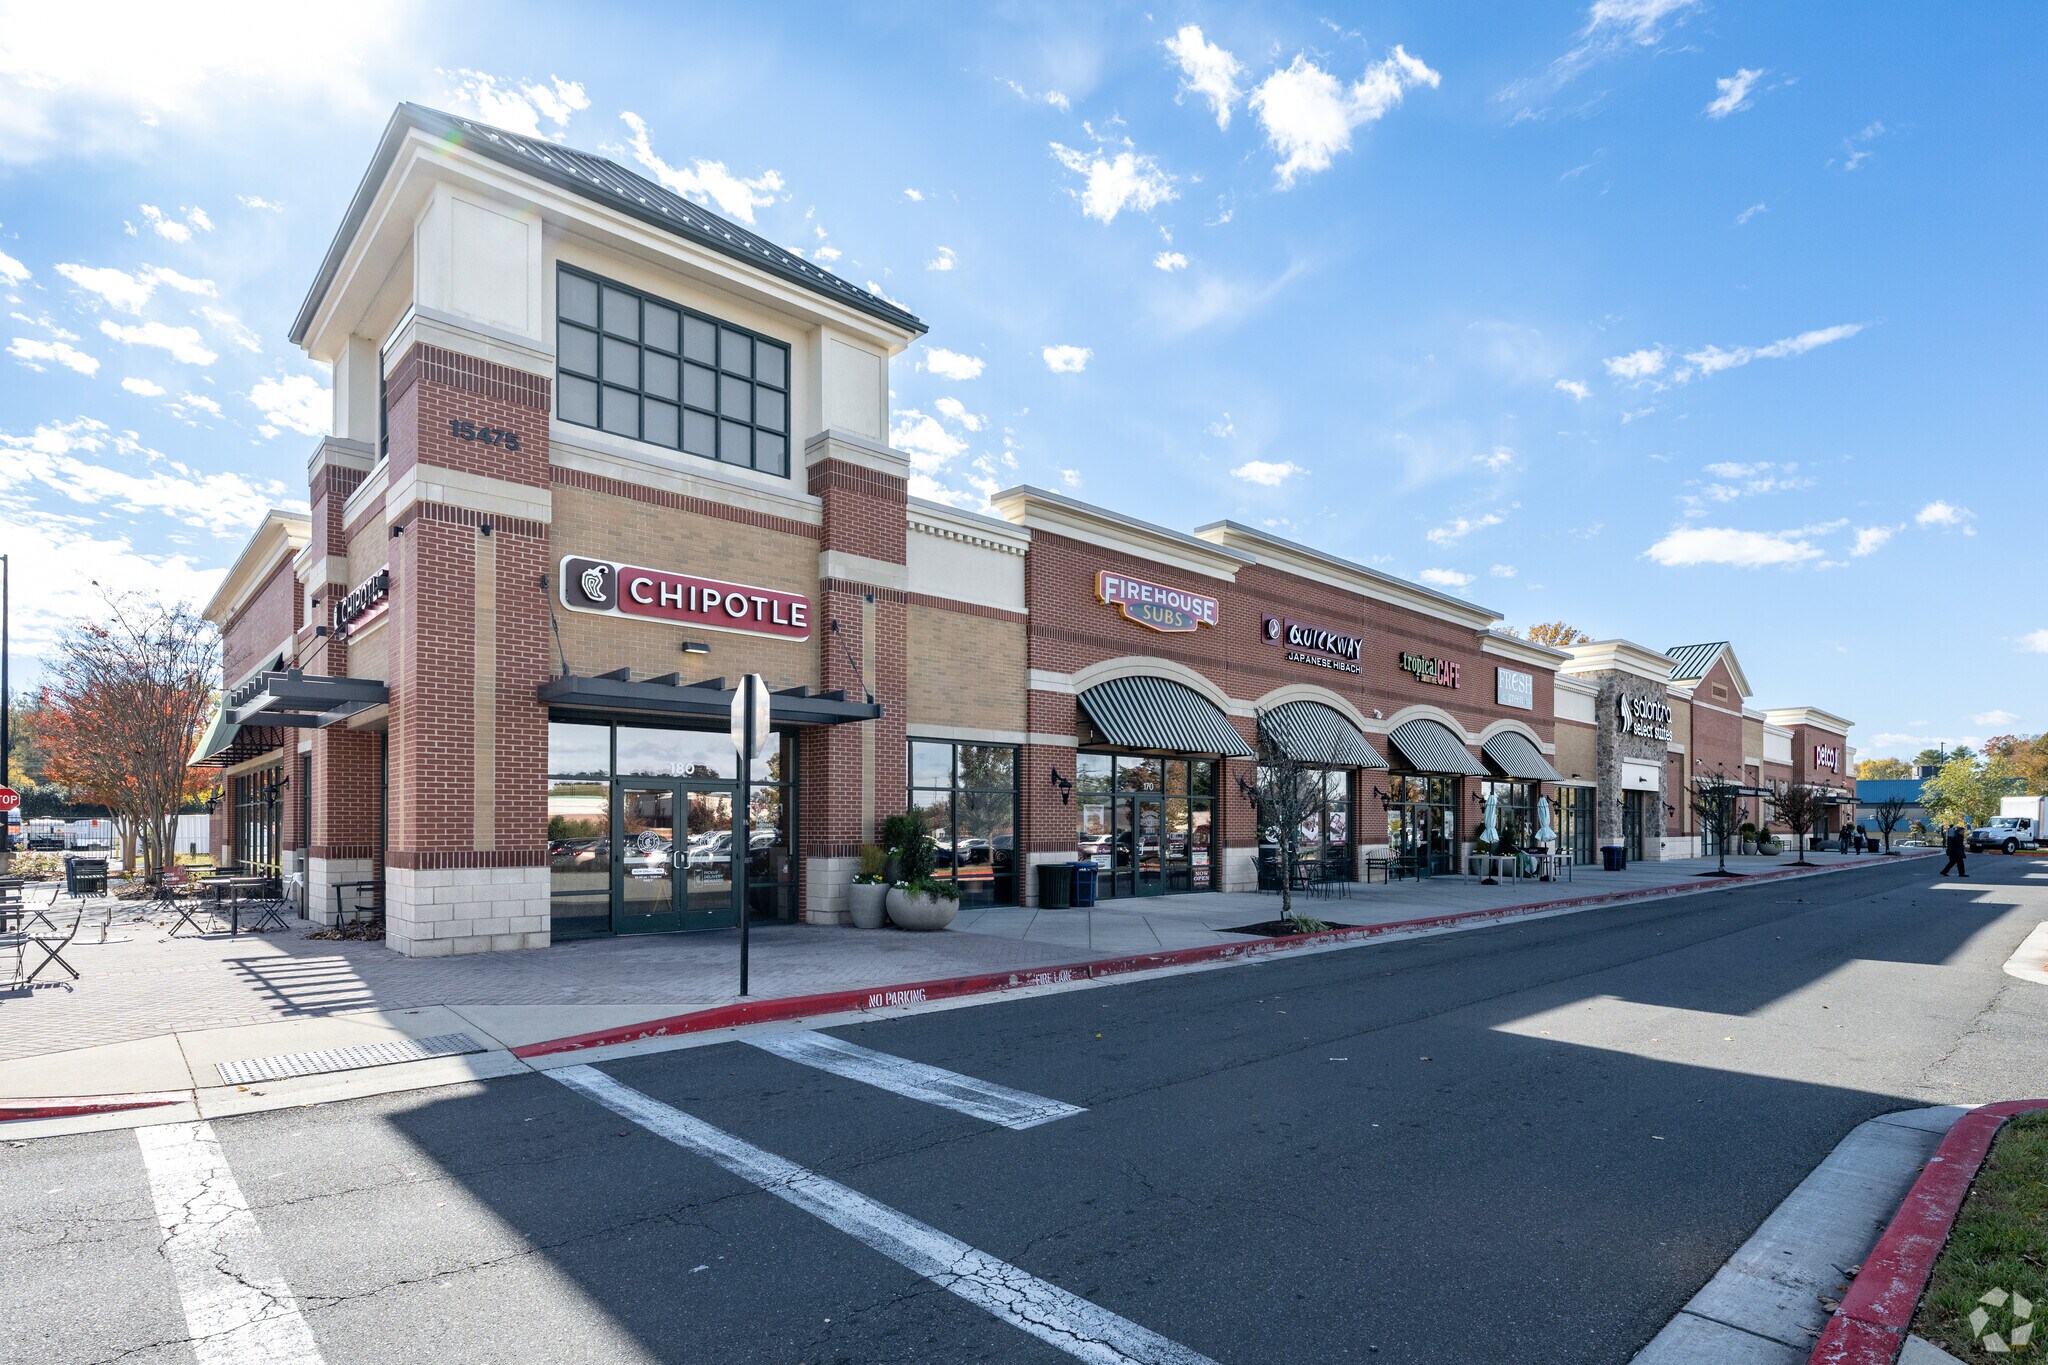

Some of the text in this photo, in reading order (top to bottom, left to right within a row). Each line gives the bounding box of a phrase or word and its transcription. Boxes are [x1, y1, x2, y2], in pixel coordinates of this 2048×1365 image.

[449, 419, 520, 451] 15475
[630, 577, 808, 628] CHIPOTLE
[1104, 576, 1215, 626] FIREHOUSE
[1142, 604, 1183, 627] SUBS
[1289, 624, 1363, 660] QUICKWAY
[1288, 652, 1363, 675] JAPANESE HIBACHI
[1403, 652, 1461, 689] tropical CAFE
[1633, 718, 1673, 742] select suites
[670, 761, 695, 775] 180
[1816, 743, 1835, 771] petco
[1143, 782, 1155, 791] 170
[868, 988, 927, 1008] NO PARKING
